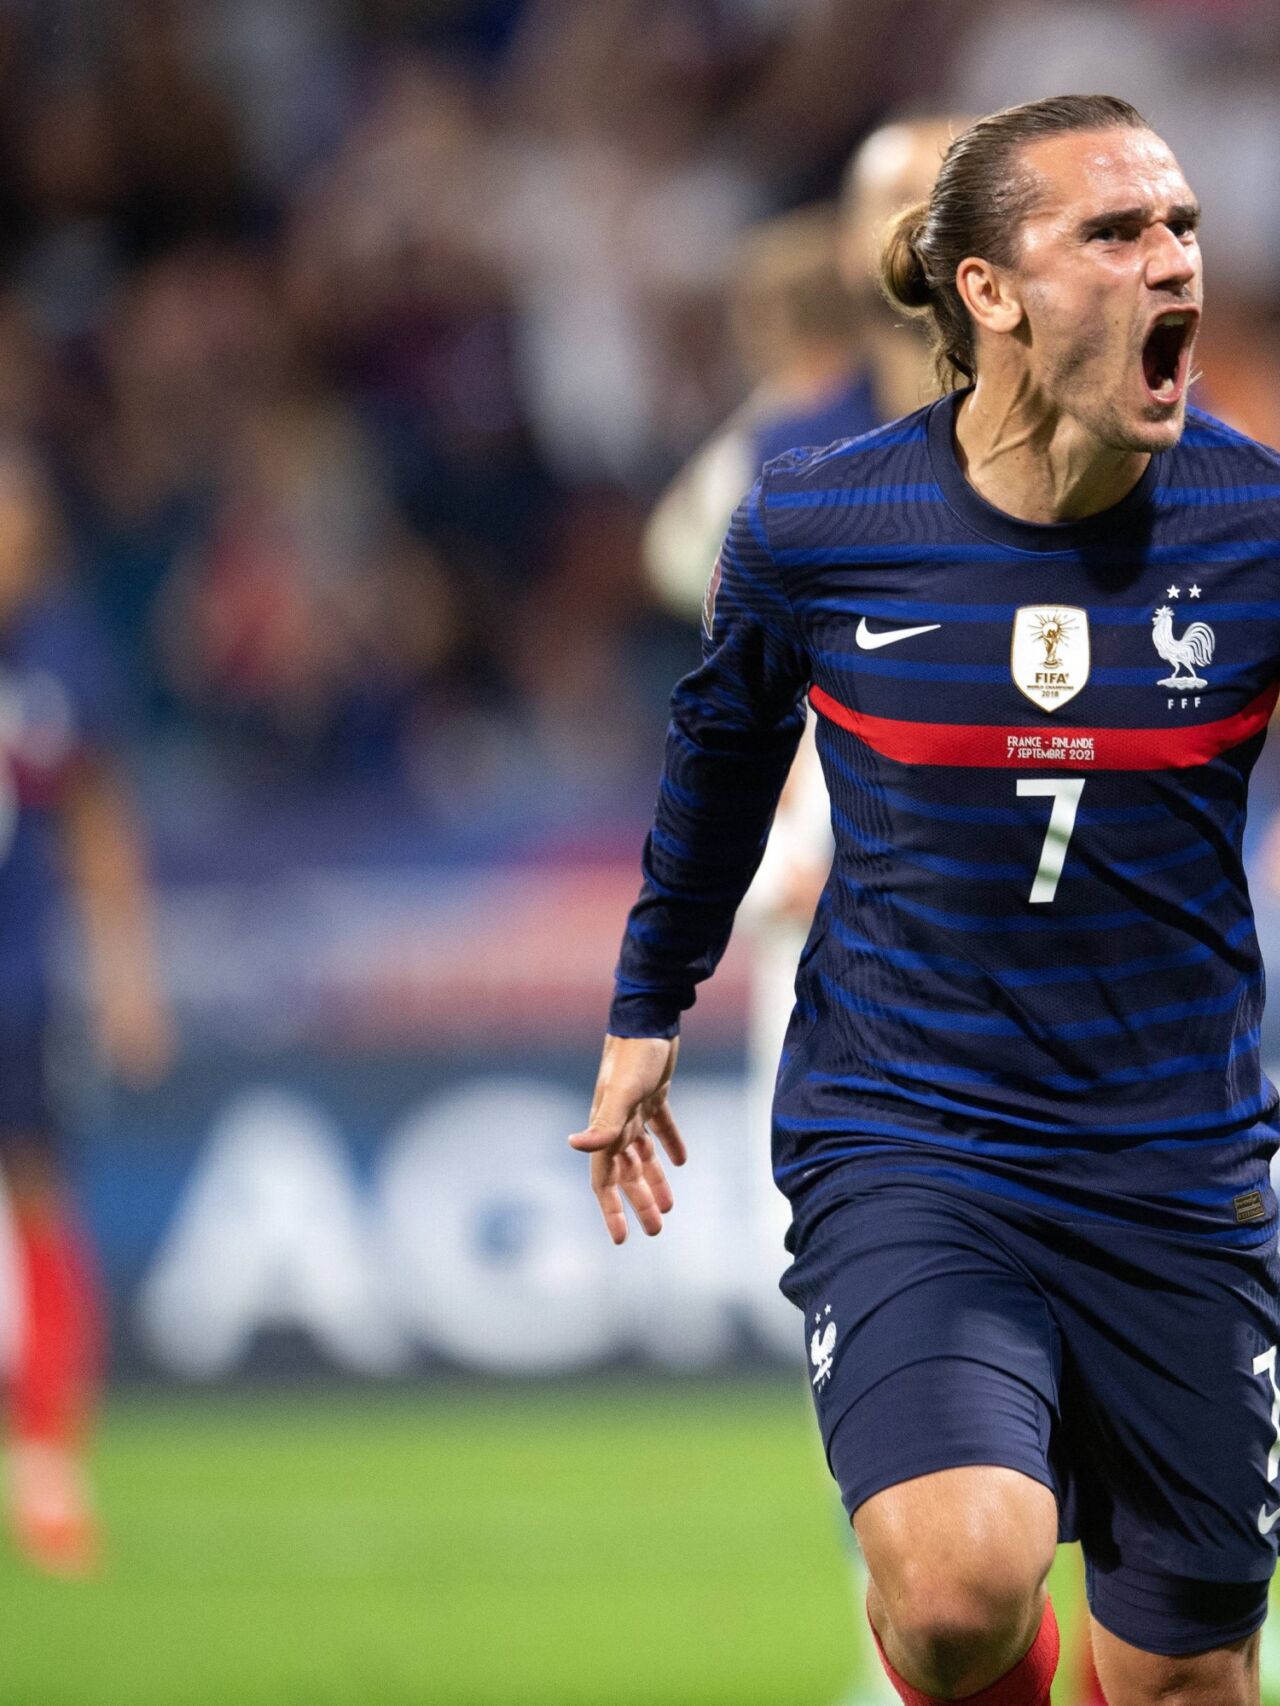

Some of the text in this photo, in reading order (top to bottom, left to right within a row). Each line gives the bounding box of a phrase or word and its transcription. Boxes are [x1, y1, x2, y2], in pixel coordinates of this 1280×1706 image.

[1035, 672, 1066, 684] FIFA
[1041, 690, 1059, 698] 2018
[1007, 736, 1042, 748] FRANCE
[1051, 737, 1094, 749] FINLANDE
[1007, 748, 1095, 761] 7 SEPTEMBRE 2021
[1016, 778, 1086, 904] 7
